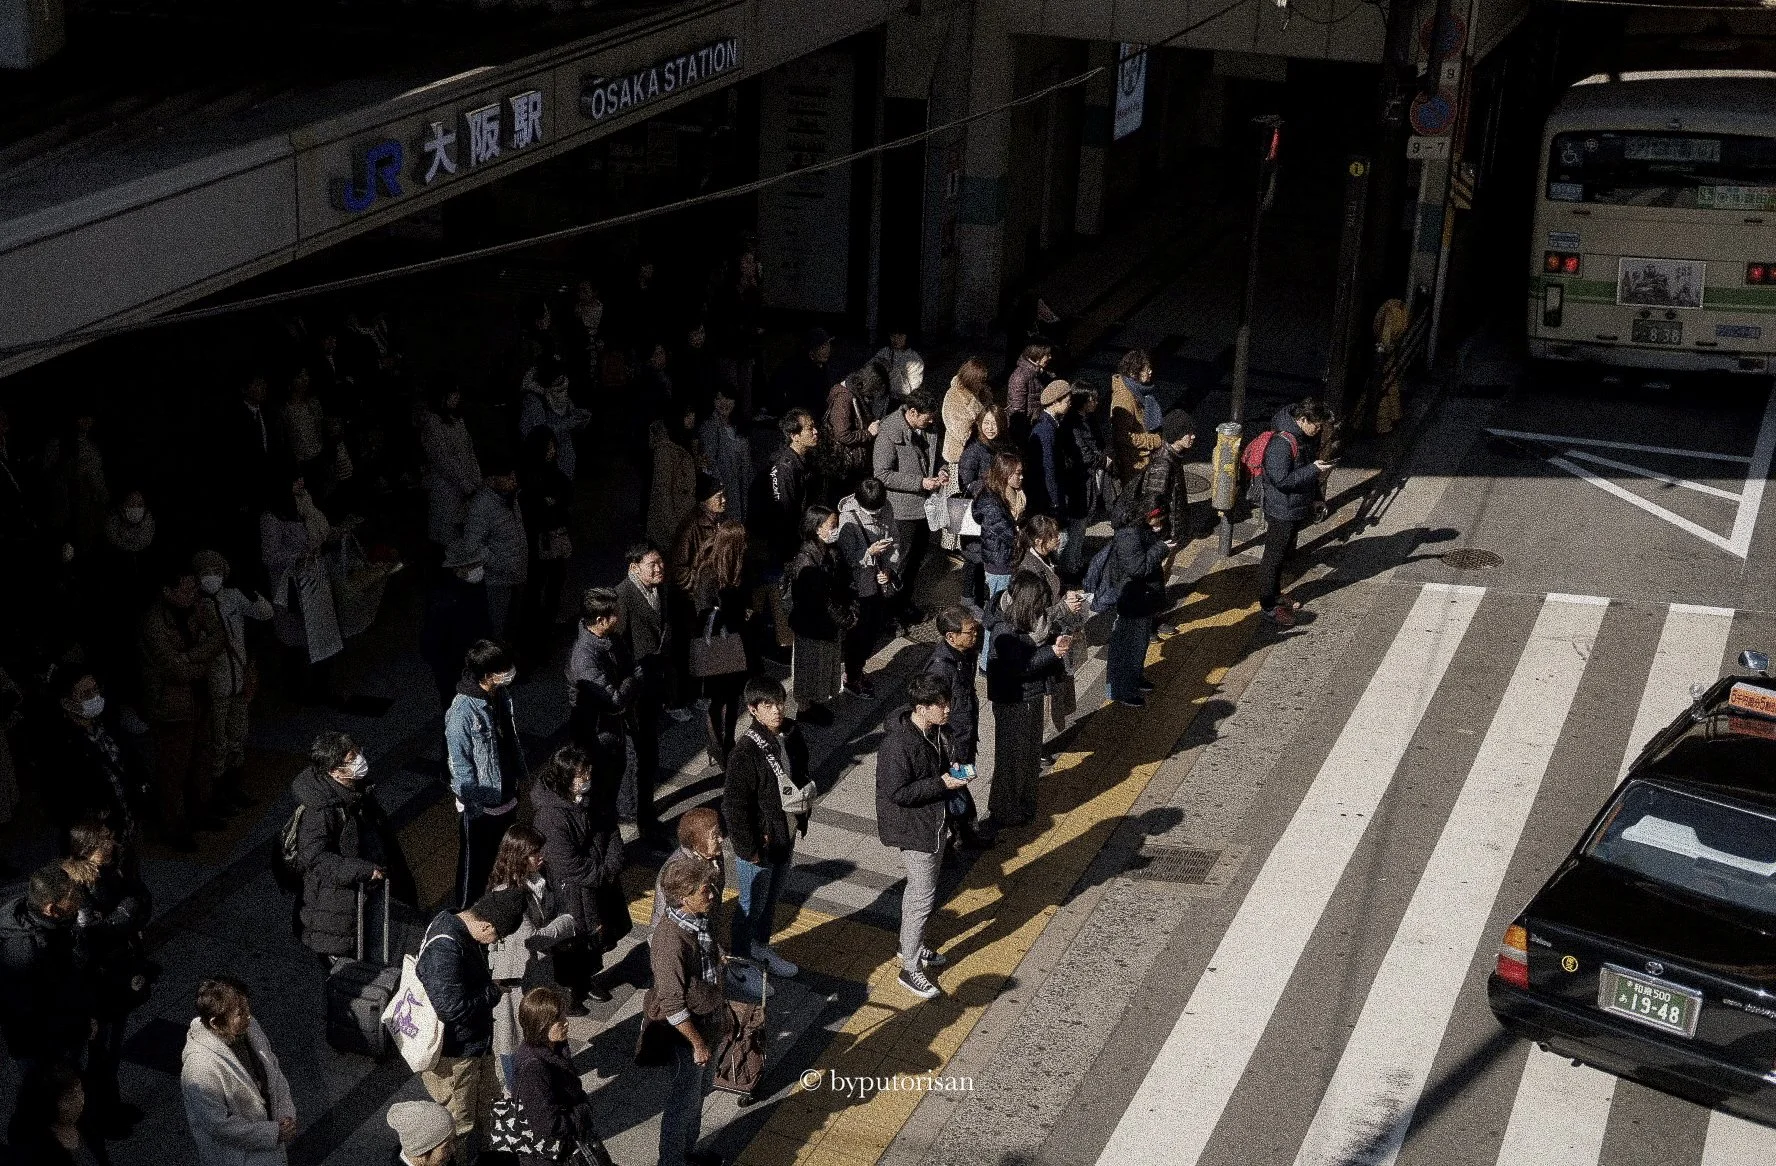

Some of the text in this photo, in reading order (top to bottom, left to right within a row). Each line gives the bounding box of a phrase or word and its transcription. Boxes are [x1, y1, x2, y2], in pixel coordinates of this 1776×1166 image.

[664, 41, 738, 92] STATION
[343, 91, 543, 212] JR 大阪駅
[1631, 993, 1680, 1024] 19-48
[1634, 983, 1671, 1002] 和泉500
